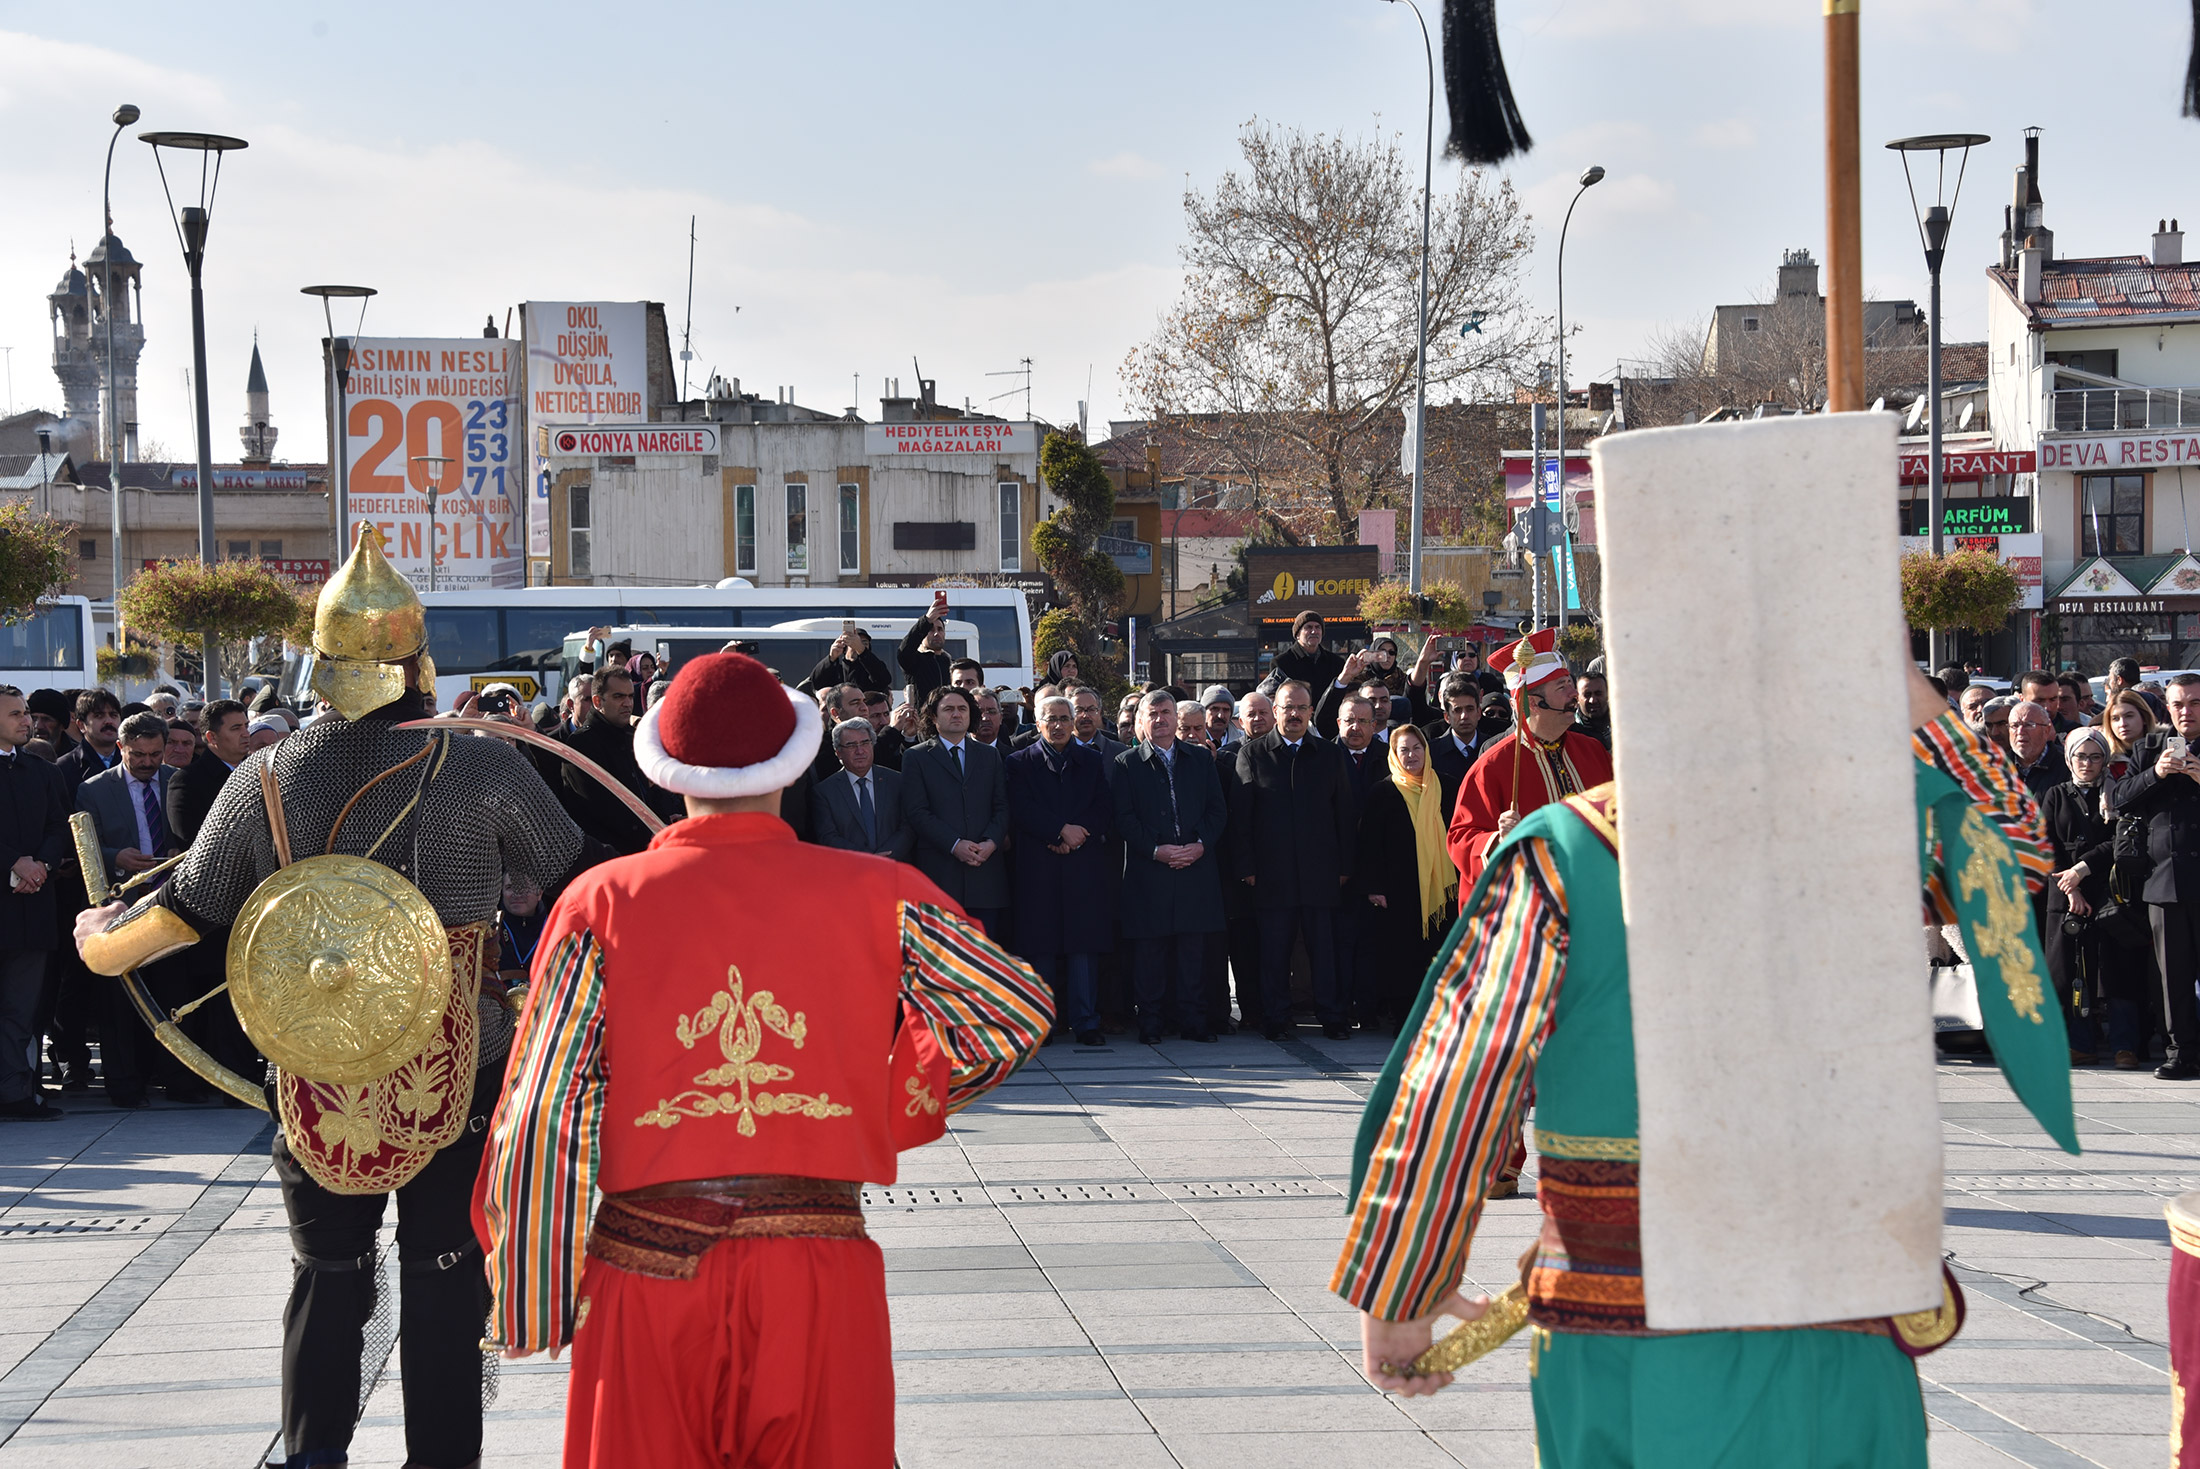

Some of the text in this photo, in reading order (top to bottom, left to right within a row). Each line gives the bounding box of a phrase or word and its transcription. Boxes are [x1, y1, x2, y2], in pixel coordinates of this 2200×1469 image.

[567, 306, 602, 332] OKU,
[558, 331, 613, 361] DÜŞÜN,
[346, 348, 508, 373] ASIMIN NESLİ
[554, 363, 617, 388] UYGULA,
[347, 374, 509, 399] DİRİLİŞİN MÜJDECİSİ
[466, 400, 508, 430] 23
[973, 425, 1013, 439] EŞYA
[348, 398, 464, 496] 20
[467, 433, 509, 462] 53
[580, 433, 633, 453] KONYA
[898, 439, 1002, 453] MAĞAZALARI
[1898, 454, 2027, 475] TARANT
[2042, 443, 2108, 467] DEVA
[181, 476, 304, 489] SAA HAC MARKET
[467, 466, 505, 495] 71
[349, 497, 510, 517] HEDEFLERİN KOŞAN BİR
[1943, 505, 2008, 523] ARFÜM
[1919, 525, 2022, 535] EANSLARI
[282, 562, 323, 572] EŞYA
[417, 575, 454, 583] GEÇLİK
[2059, 601, 2164, 613] DEVA RESTAURANT
